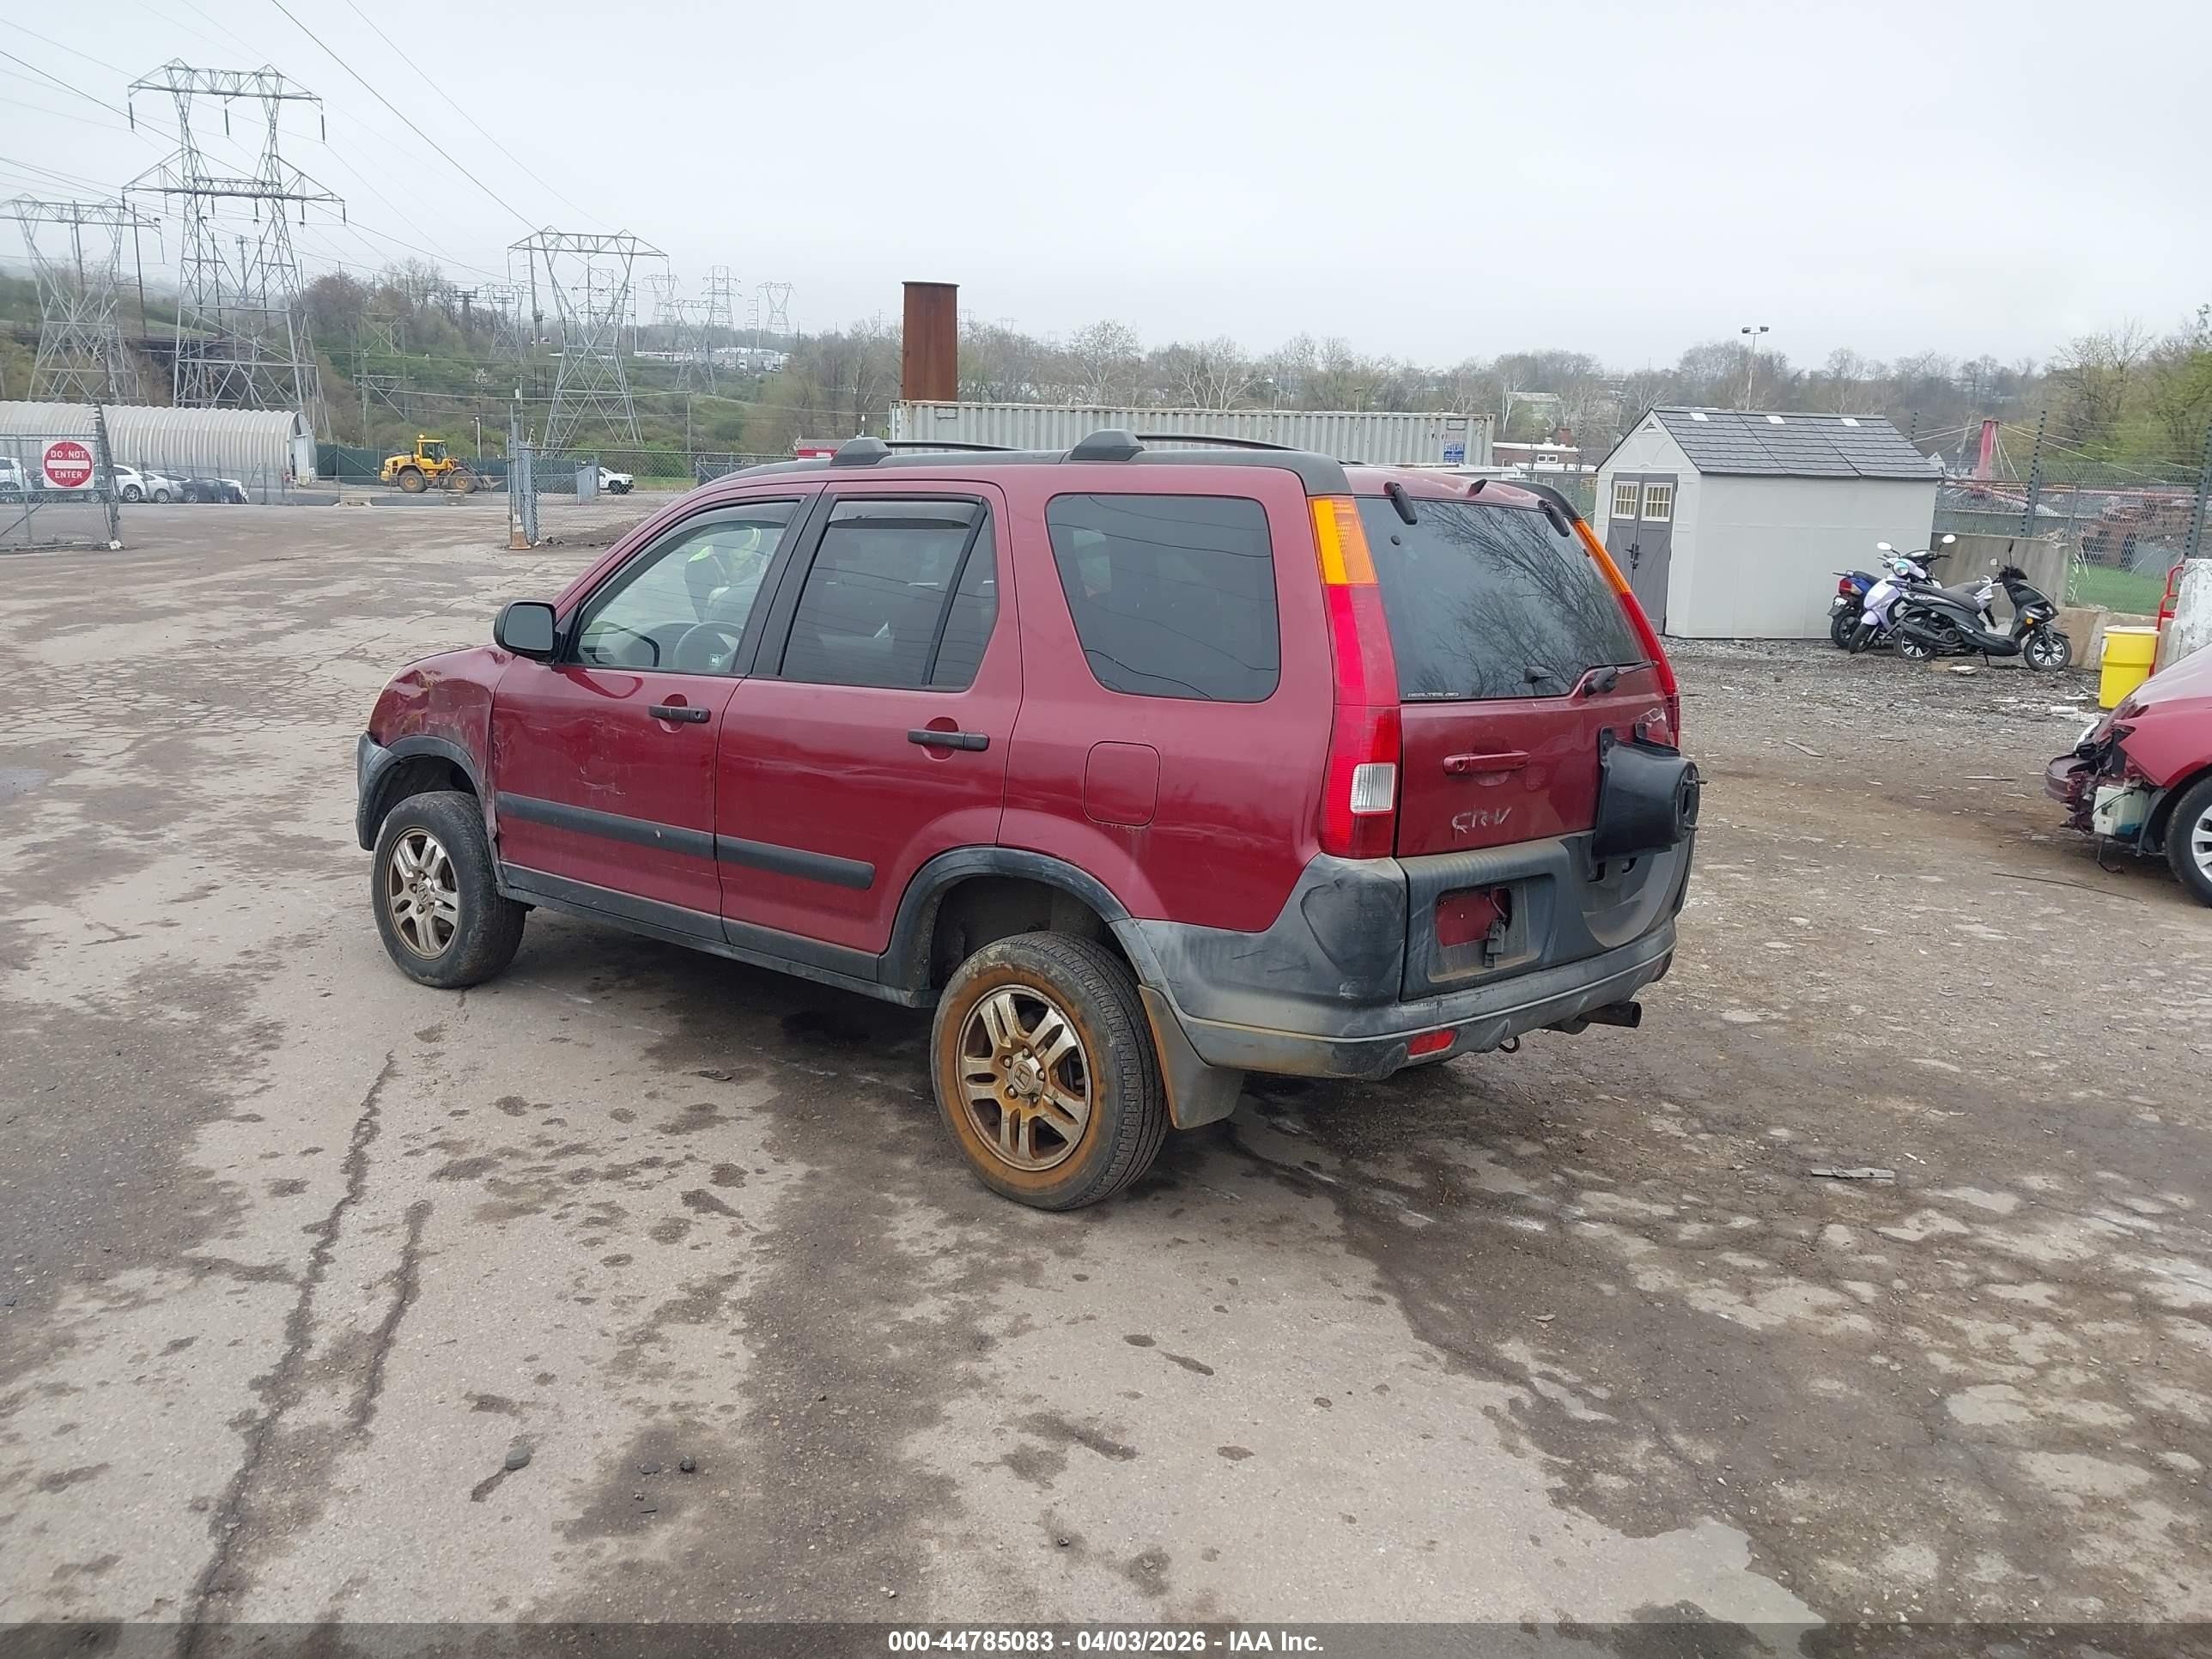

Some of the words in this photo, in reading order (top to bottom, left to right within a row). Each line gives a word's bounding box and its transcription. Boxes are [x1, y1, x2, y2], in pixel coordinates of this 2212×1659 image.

[50, 450, 64, 459] DO
[68, 450, 85, 459] NOT
[54, 471, 83, 479] ENTER
